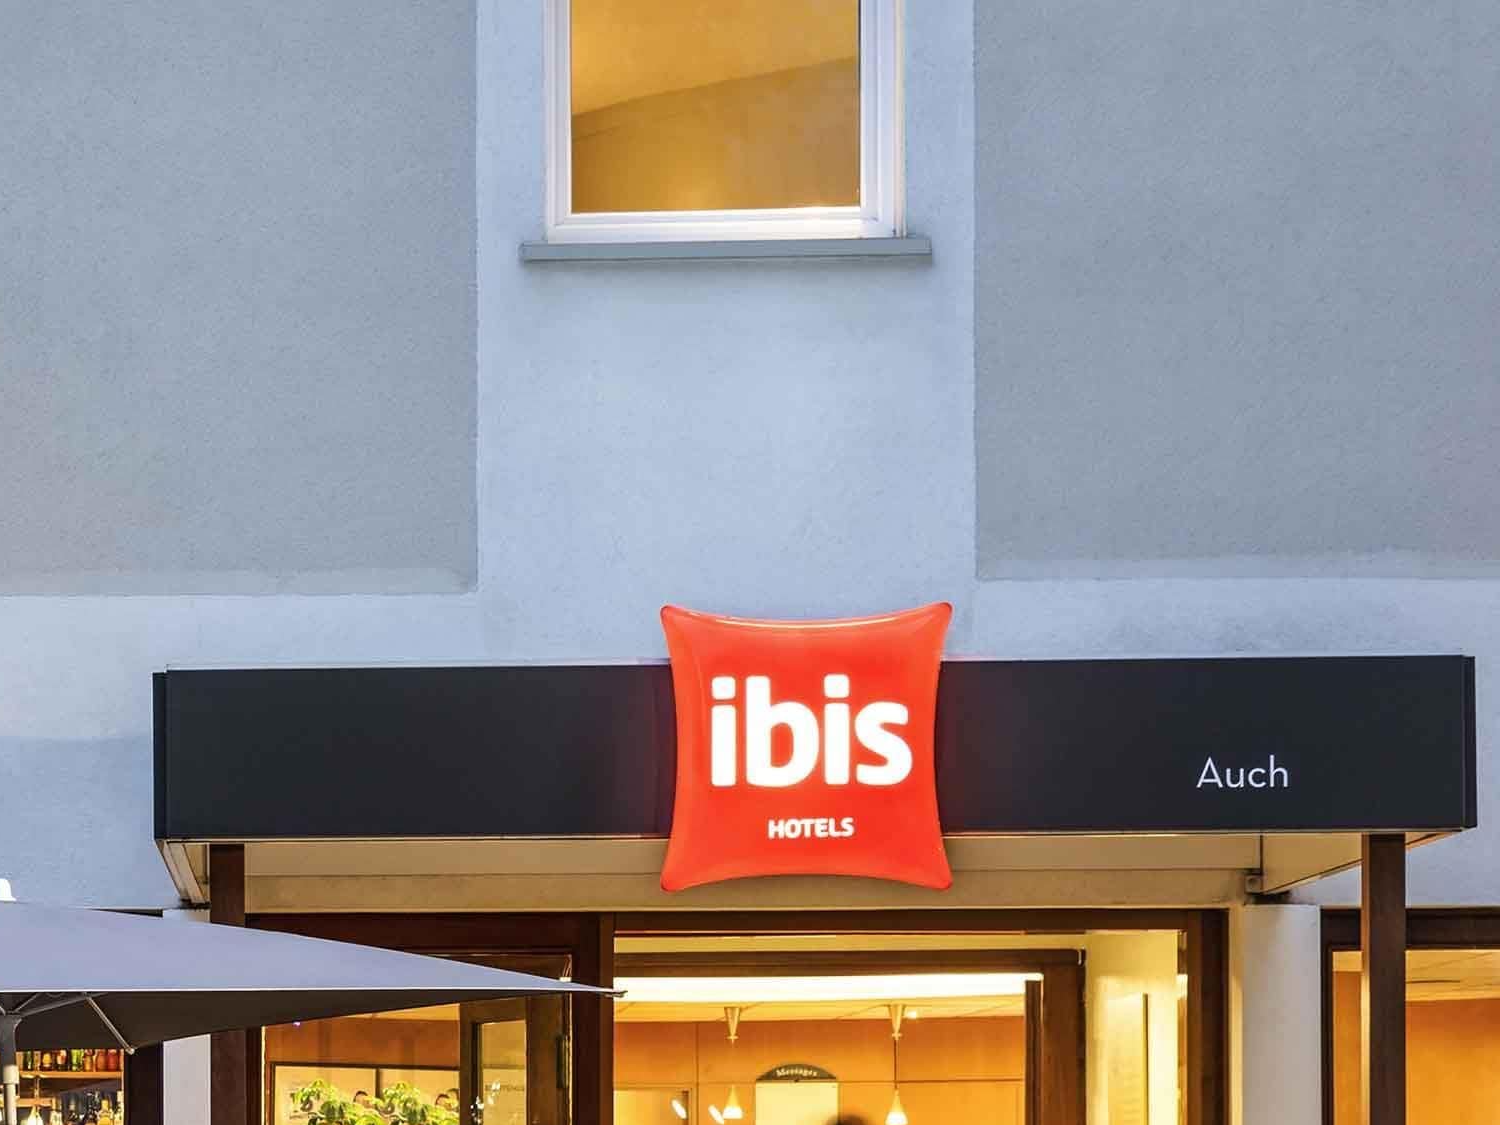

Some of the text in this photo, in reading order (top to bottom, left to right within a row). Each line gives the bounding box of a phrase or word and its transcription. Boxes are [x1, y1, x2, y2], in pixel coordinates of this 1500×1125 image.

[711, 674, 913, 788] ibis
[1196, 755, 1290, 788] Auch
[768, 817, 854, 838] HOTELS
